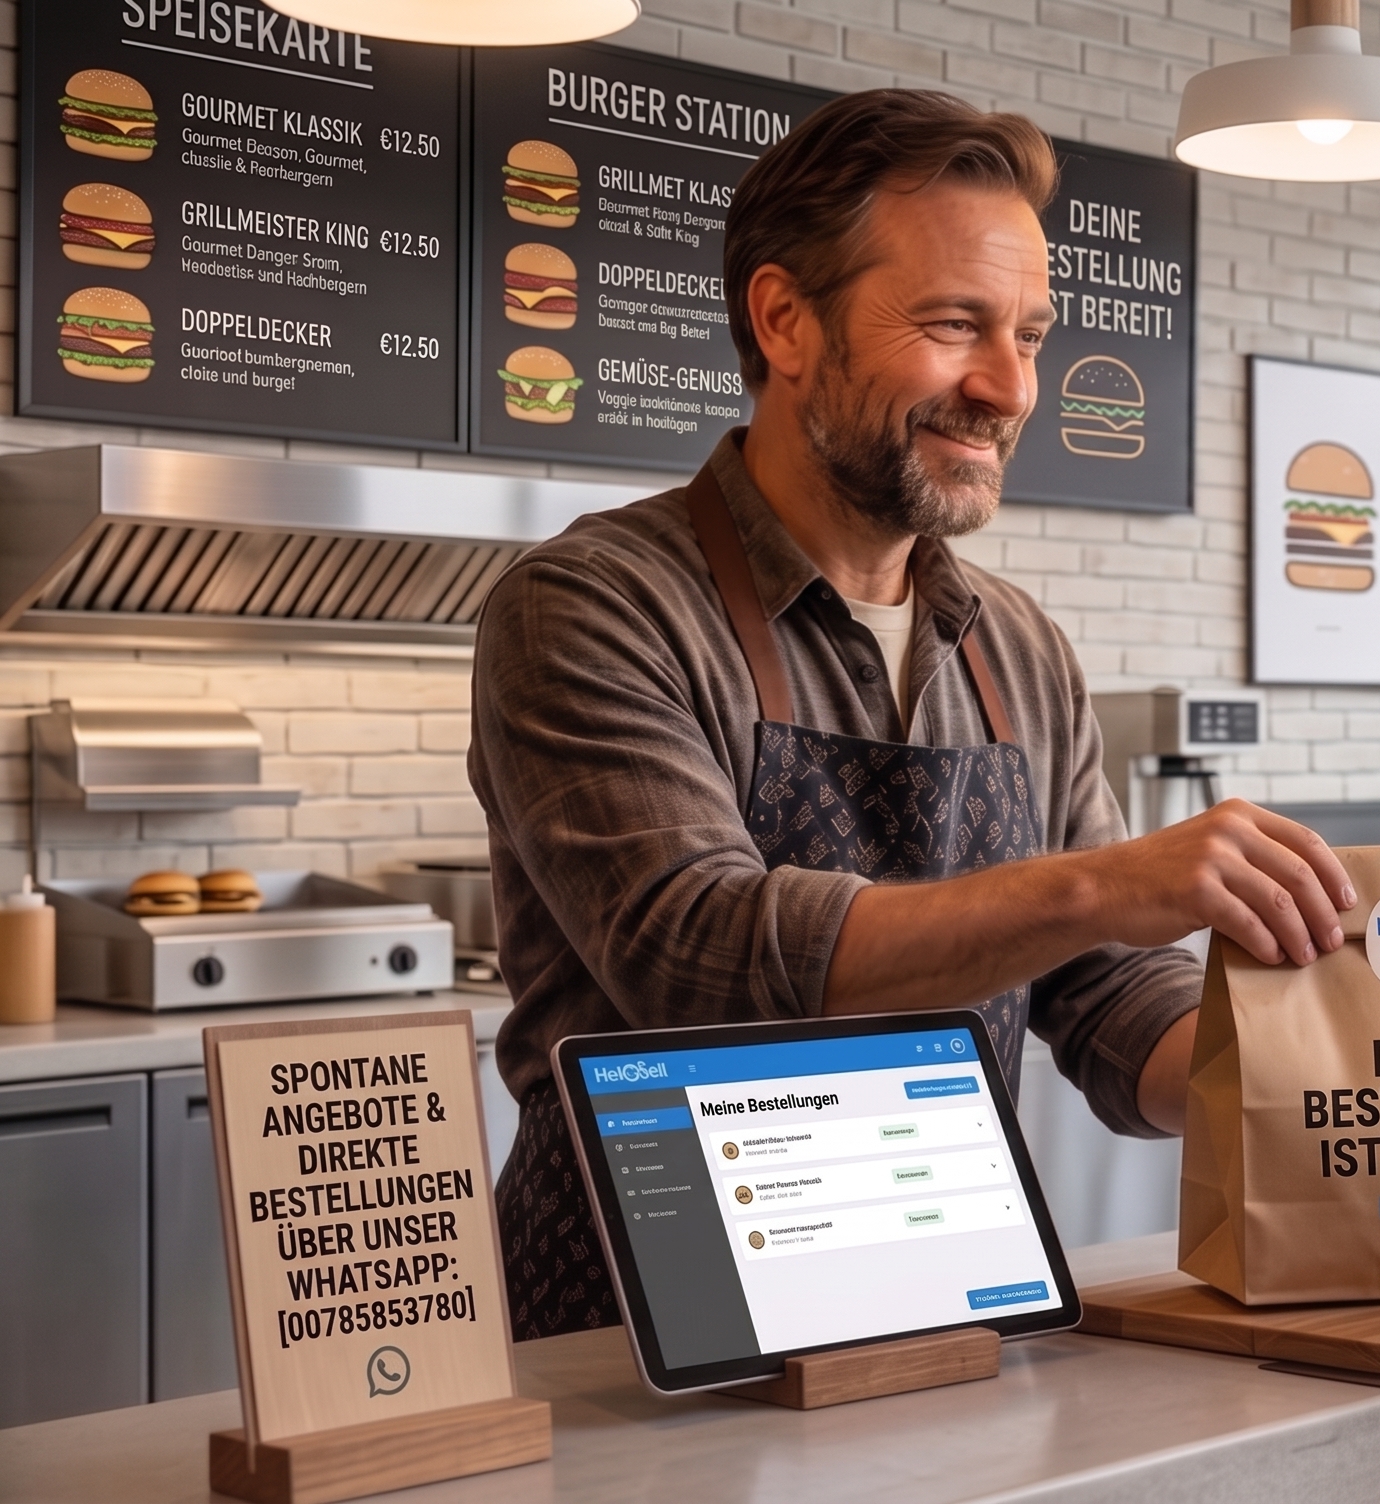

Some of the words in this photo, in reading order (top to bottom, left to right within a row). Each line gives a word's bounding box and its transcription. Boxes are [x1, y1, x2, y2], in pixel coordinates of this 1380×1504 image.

[122, 0, 373, 72] SPEISEKARTE
[182, 92, 279, 131] GOURMET
[284, 110, 363, 146] KLASSIK
[548, 67, 667, 128] BURGER
[675, 94, 790, 146] STATION
[182, 127, 242, 152] Gourmet
[305, 148, 367, 174] Gourmet,
[379, 127, 440, 158] €12.50
[235, 157, 247, 174] &
[598, 165, 684, 200] GRILLMET
[689, 180, 736, 208] KLAS
[182, 201, 320, 243] GRILLMEISTER
[326, 221, 369, 249] KING
[633, 221, 643, 236] &
[1069, 199, 1141, 244] DEINE
[182, 235, 243, 258] Gourmet
[379, 230, 440, 259] €12.50
[598, 262, 726, 301] DOPPELDECKE
[1047, 242, 1182, 296] ESTELLUNG
[182, 308, 332, 348] DOPPELDECKER
[1081, 294, 1172, 341] BEREIT!
[379, 332, 440, 359] €12.50
[222, 370, 247, 386] und
[598, 357, 743, 396] GEMÜSE-GENUSS
[270, 1052, 428, 1095] SPONTANE
[262, 1095, 419, 1138] ANGEBOTE
[427, 1092, 446, 1122] &
[700, 1098, 746, 1118] Meine
[748, 1091, 839, 1115] Bestellungen
[298, 1134, 420, 1175] DIREKTE
[249, 1169, 473, 1223] BESTELLUNGEN
[277, 1221, 355, 1261] ÜBER
[363, 1211, 457, 1251] UNSER
[287, 1253, 459, 1301] WHATSAPP:
[279, 1286, 476, 1349] [00785853780]
